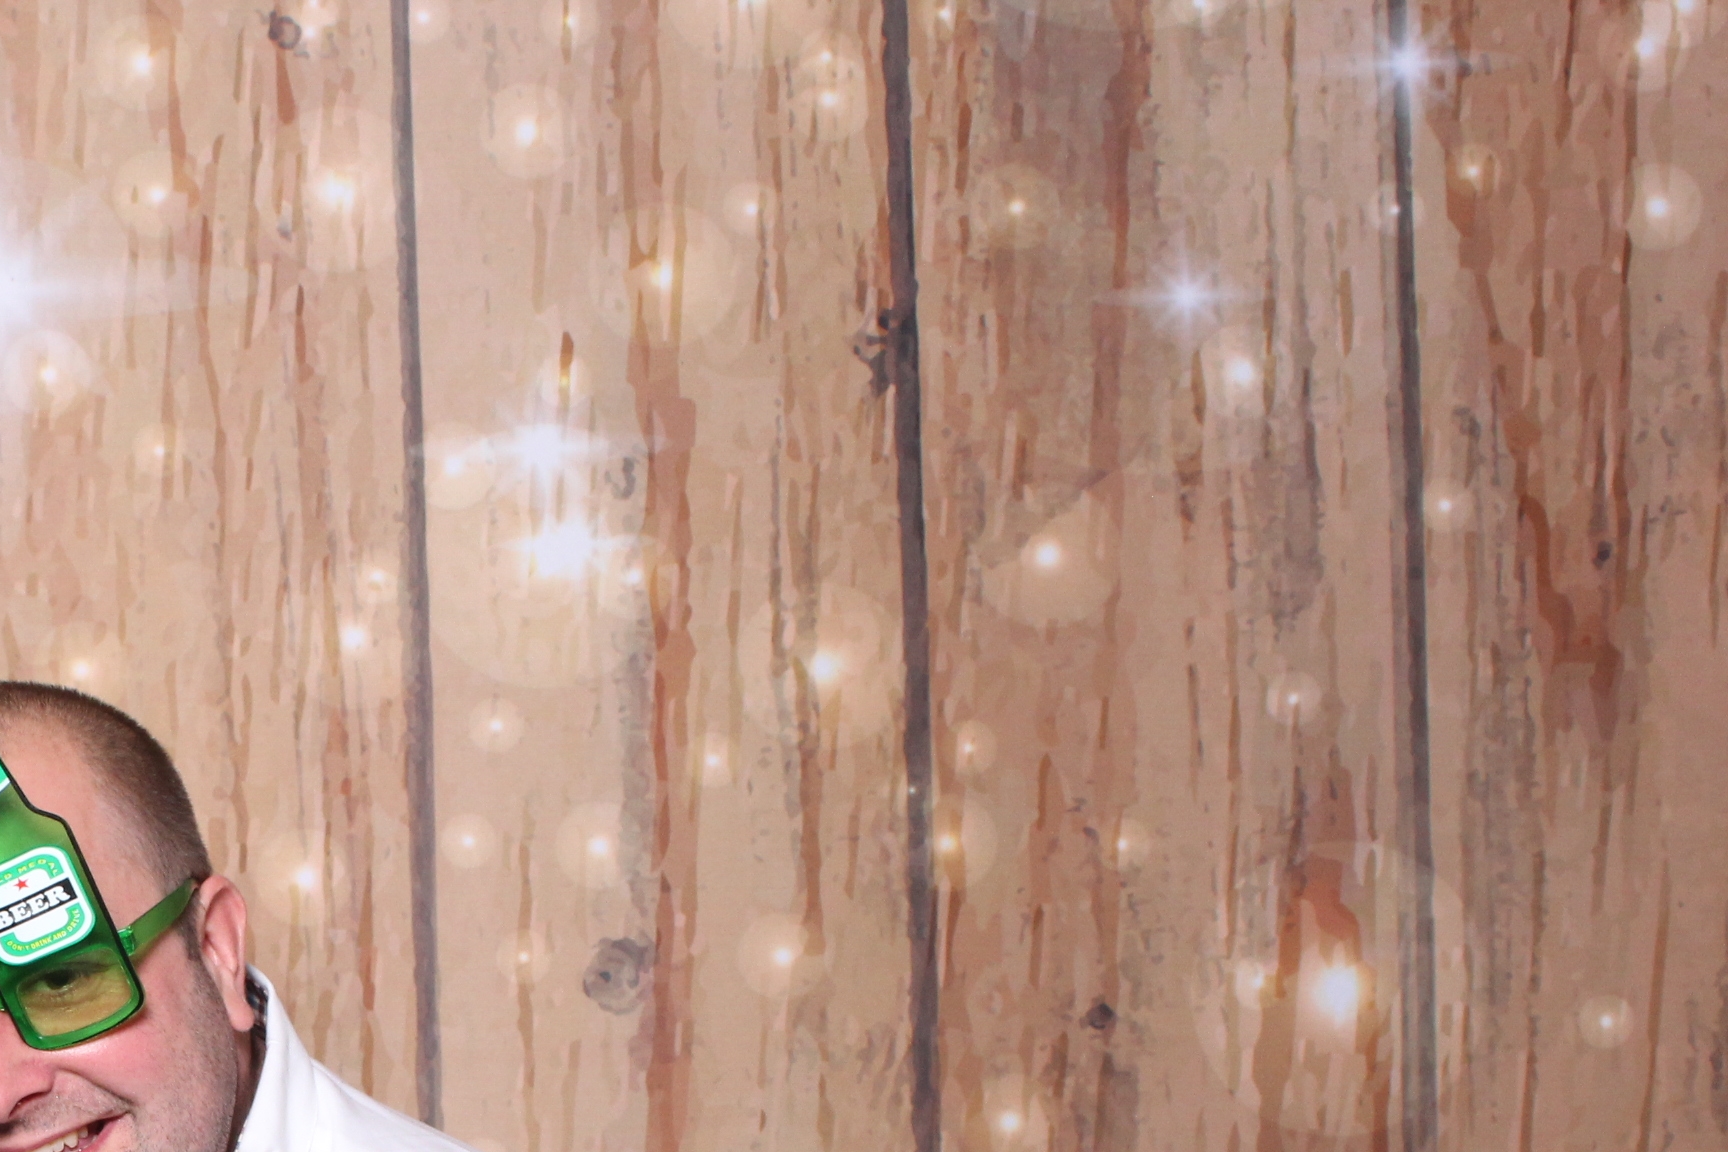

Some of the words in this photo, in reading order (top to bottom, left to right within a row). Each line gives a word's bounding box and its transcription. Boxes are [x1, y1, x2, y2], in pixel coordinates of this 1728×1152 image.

[17, 859, 59, 876] MEDAL
[6, 940, 30, 951] DON'T
[31, 936, 52, 949] DRINK
[52, 931, 67, 940] AND
[67, 909, 80, 932] DRIVE
